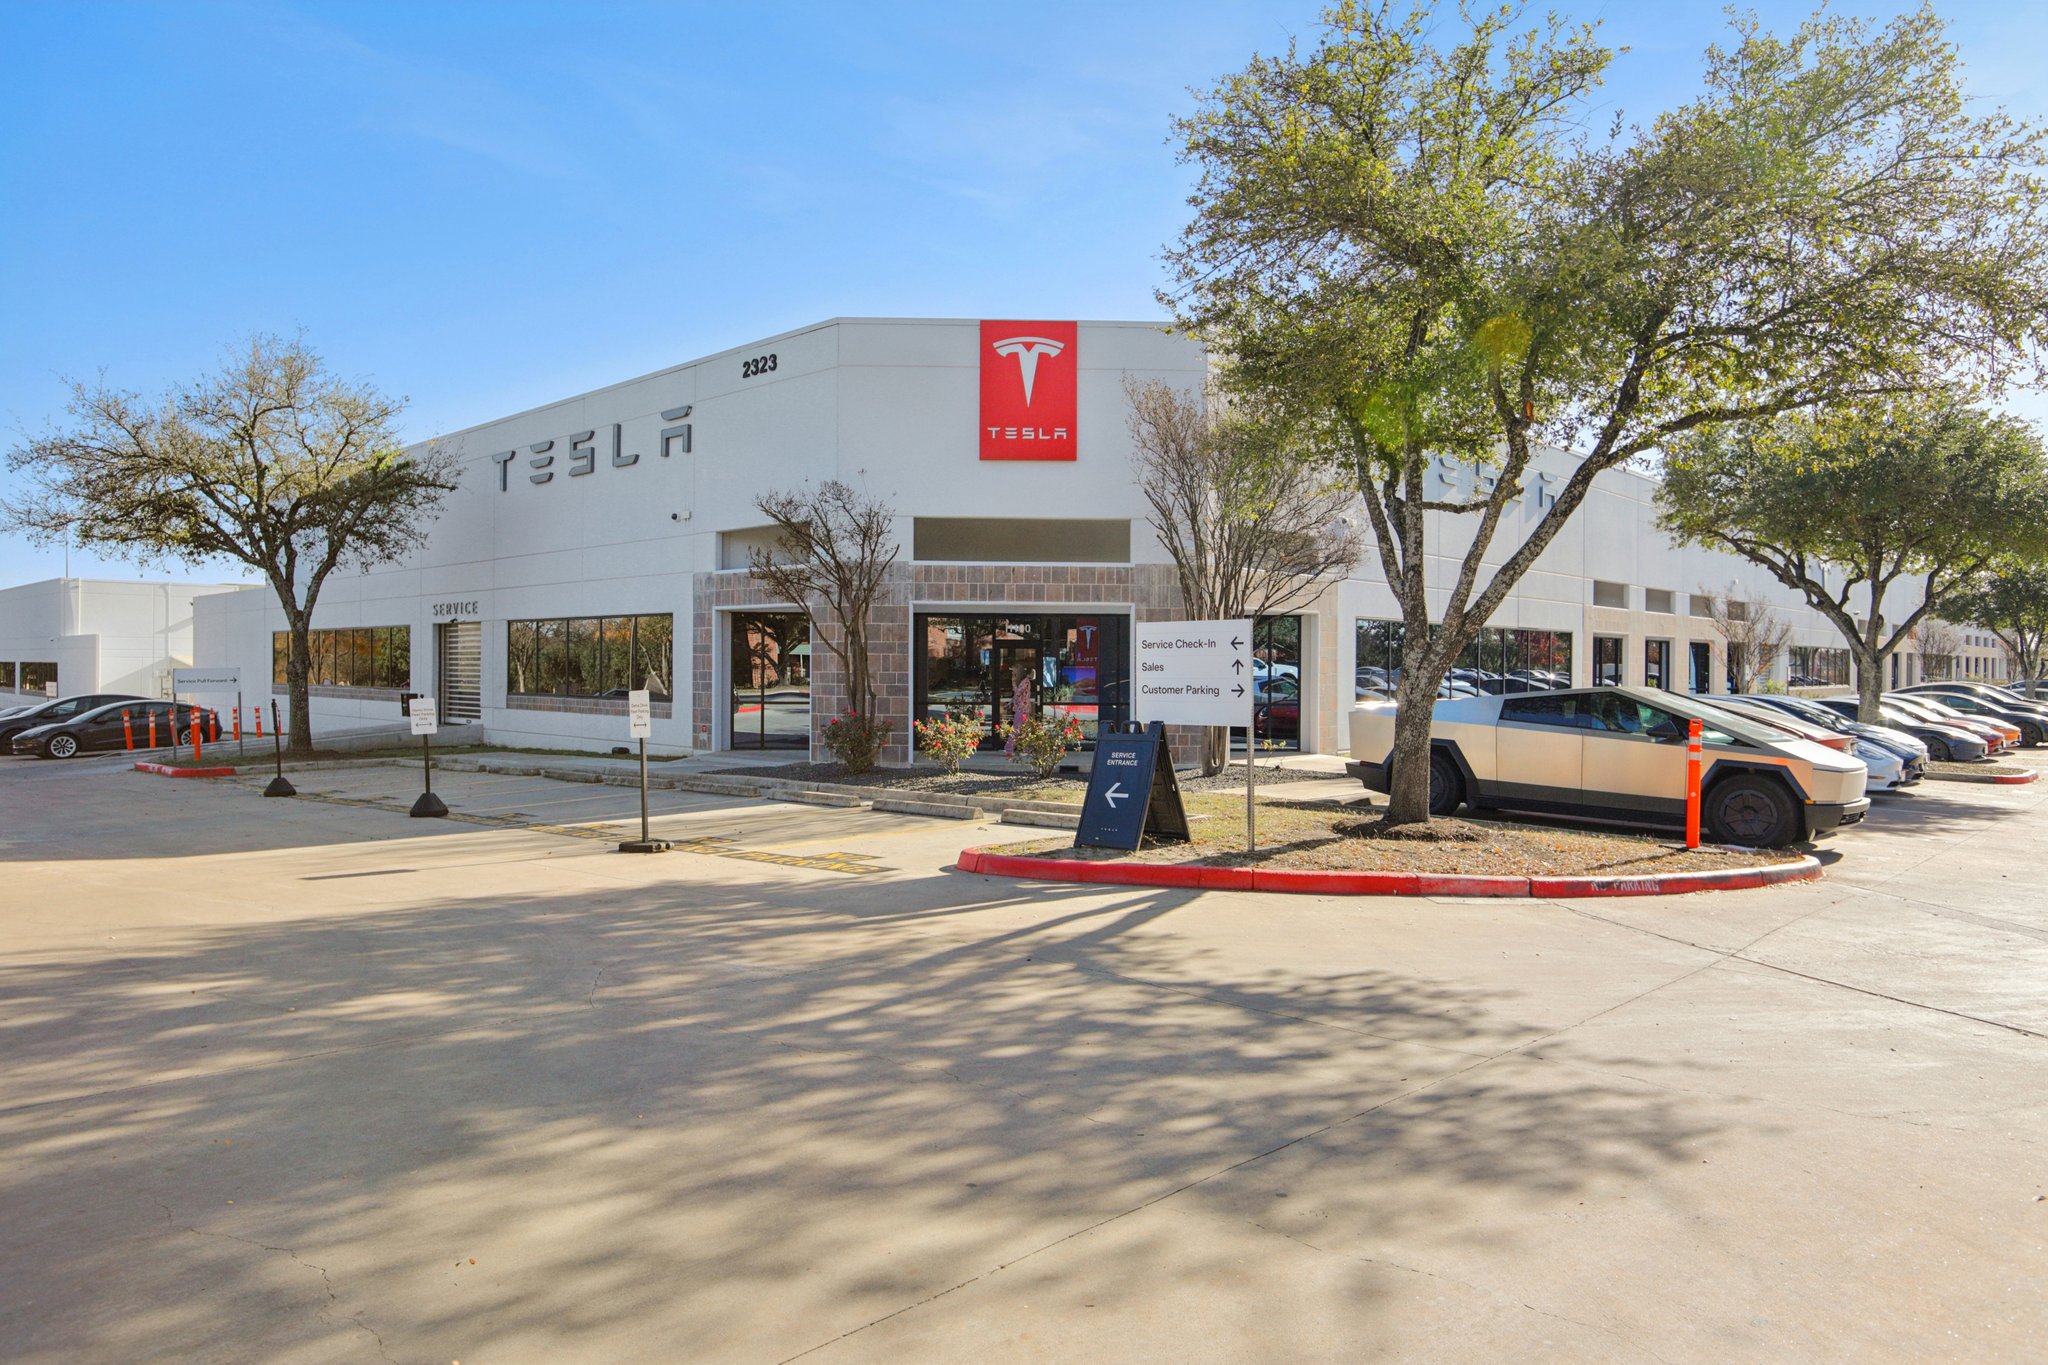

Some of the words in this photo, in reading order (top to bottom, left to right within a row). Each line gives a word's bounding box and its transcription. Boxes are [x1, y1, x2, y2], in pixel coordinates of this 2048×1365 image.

[743, 354, 777, 378] 2323
[987, 427, 1067, 440] TESLA
[492, 405, 692, 492] TESLA
[433, 601, 478, 616] SERVICE
[1142, 640, 1173, 649] Service
[1175, 639, 1217, 649] Check-In
[1141, 662, 1164, 672] Sales
[1141, 684, 1184, 694] Customer
[1186, 684, 1220, 697] Parking
[1613, 878, 1660, 892] PARKING
